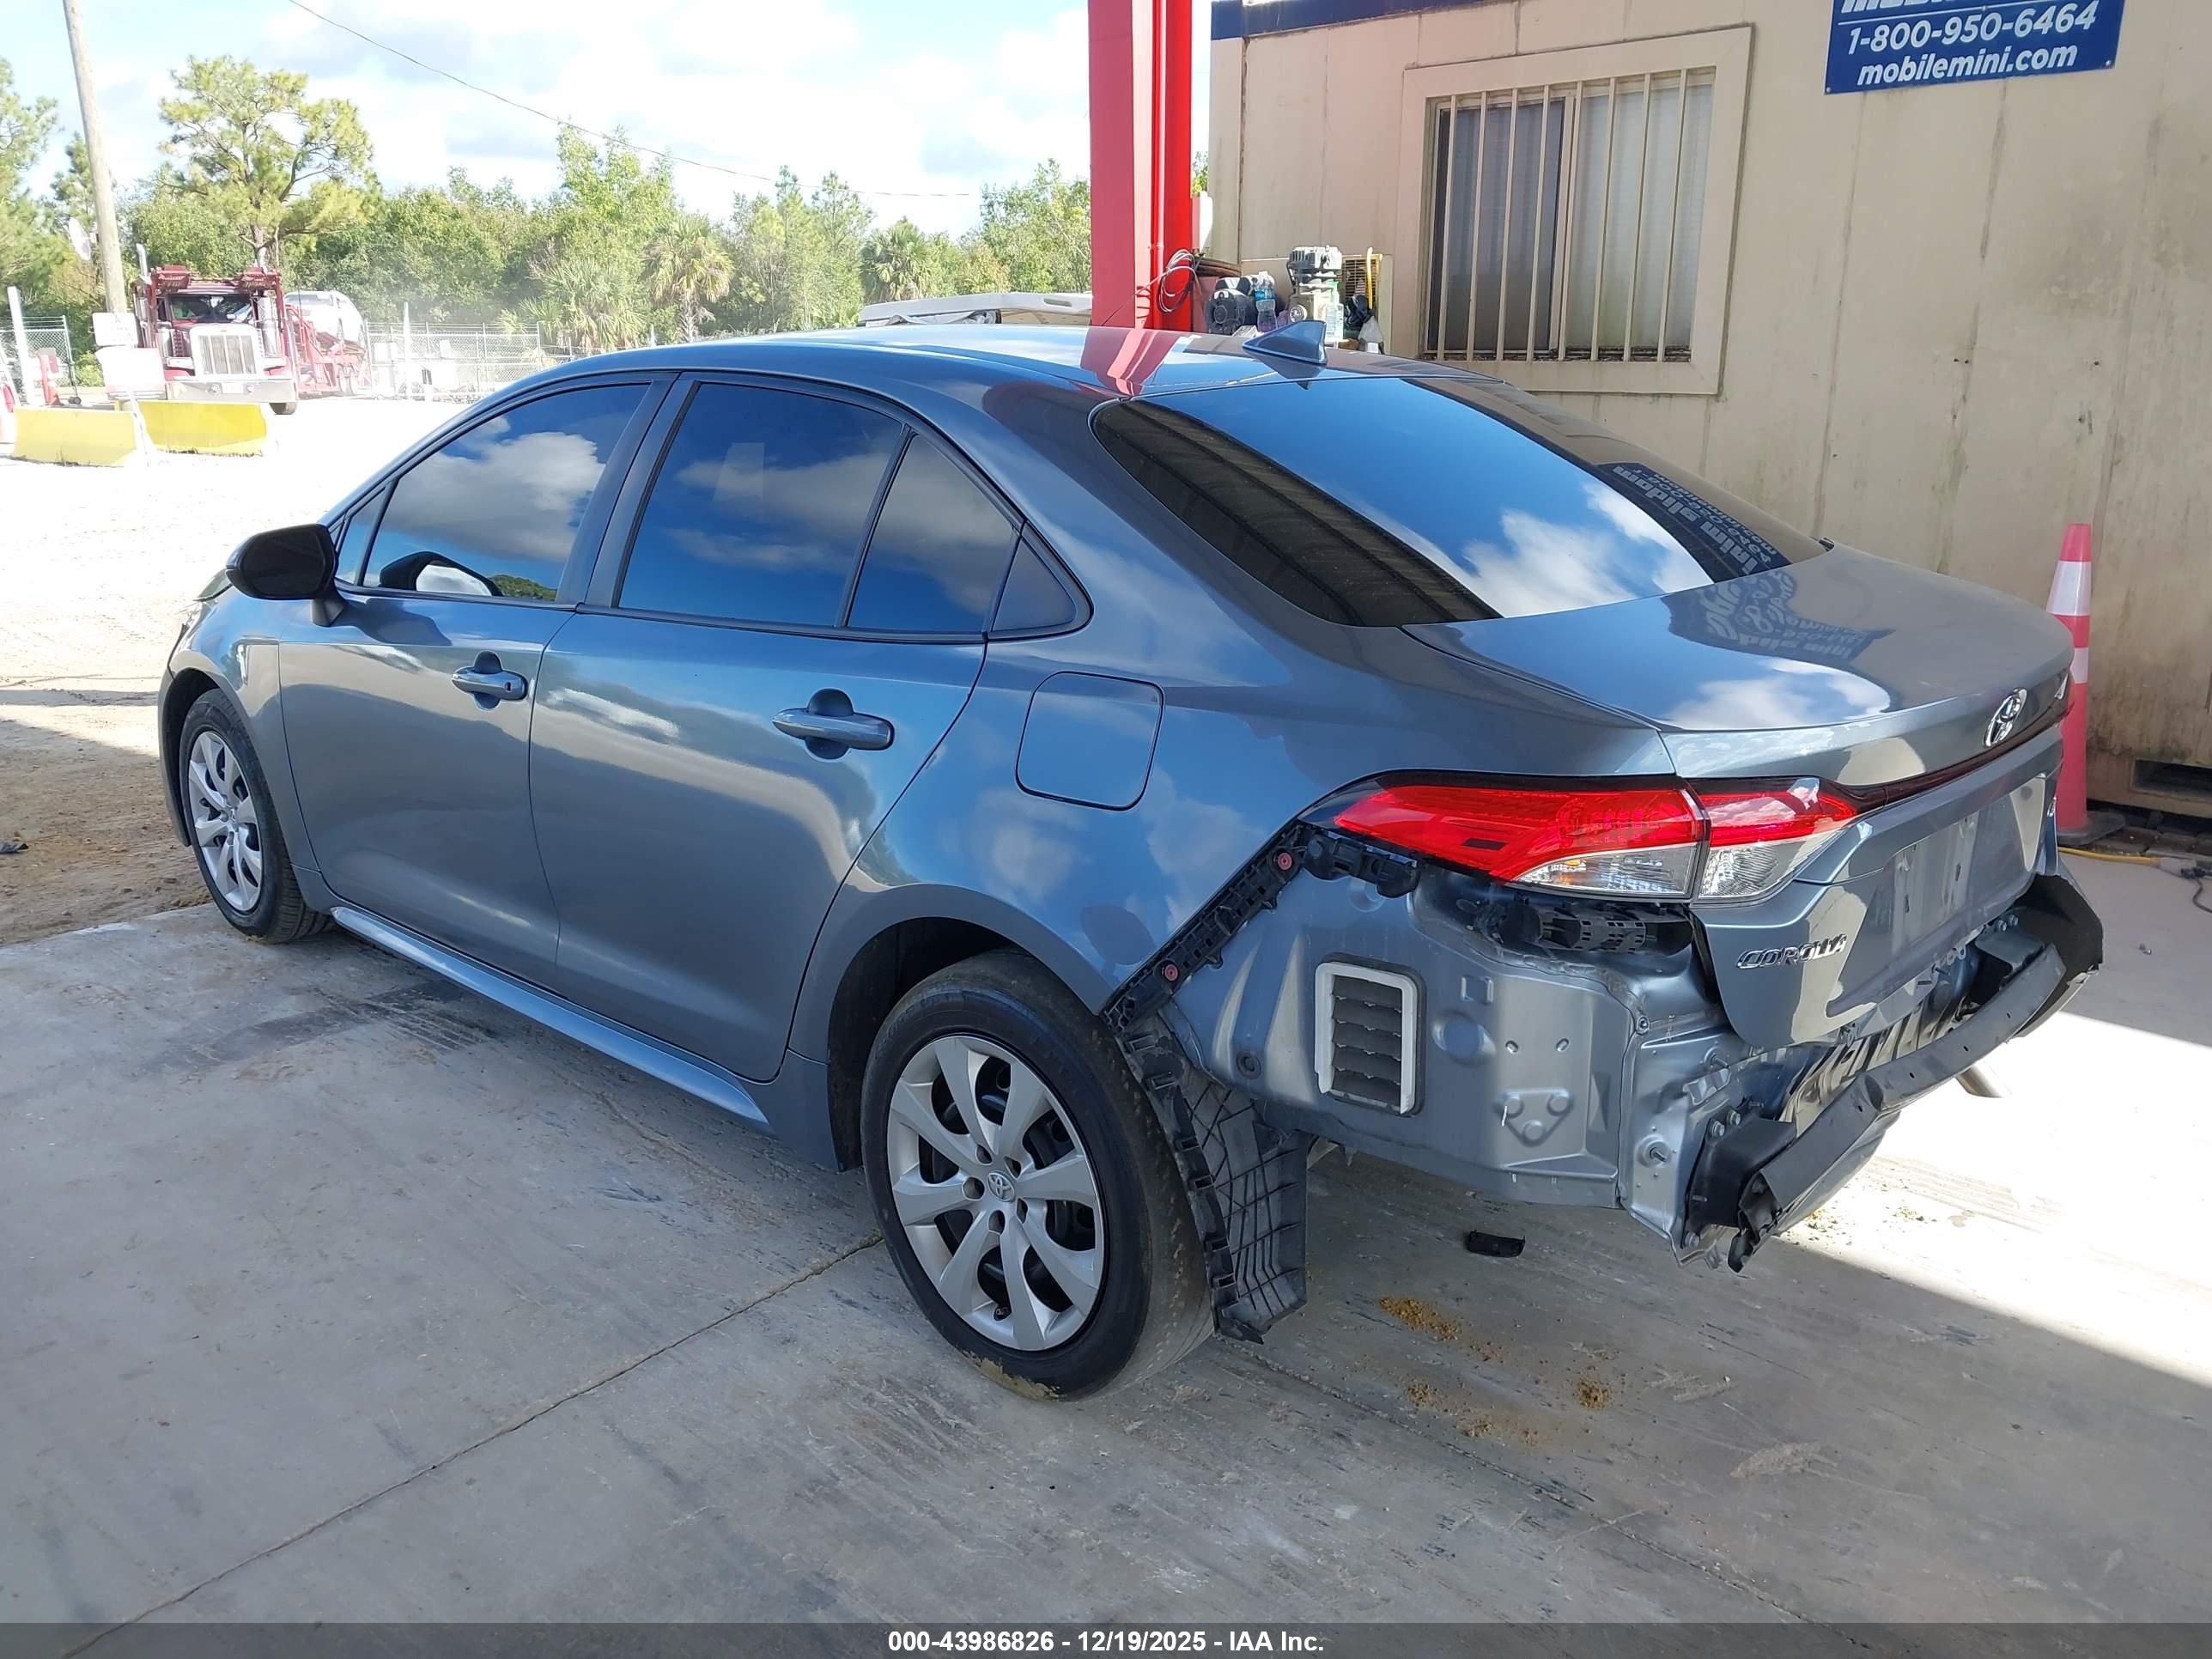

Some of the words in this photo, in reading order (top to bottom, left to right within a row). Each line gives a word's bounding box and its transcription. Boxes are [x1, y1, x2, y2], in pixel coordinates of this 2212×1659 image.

[1848, 0, 2100, 55] 1-800-950-6464
[1856, 45, 2078, 86] mobilemini.com
[1736, 933, 1848, 970] COROLLA
